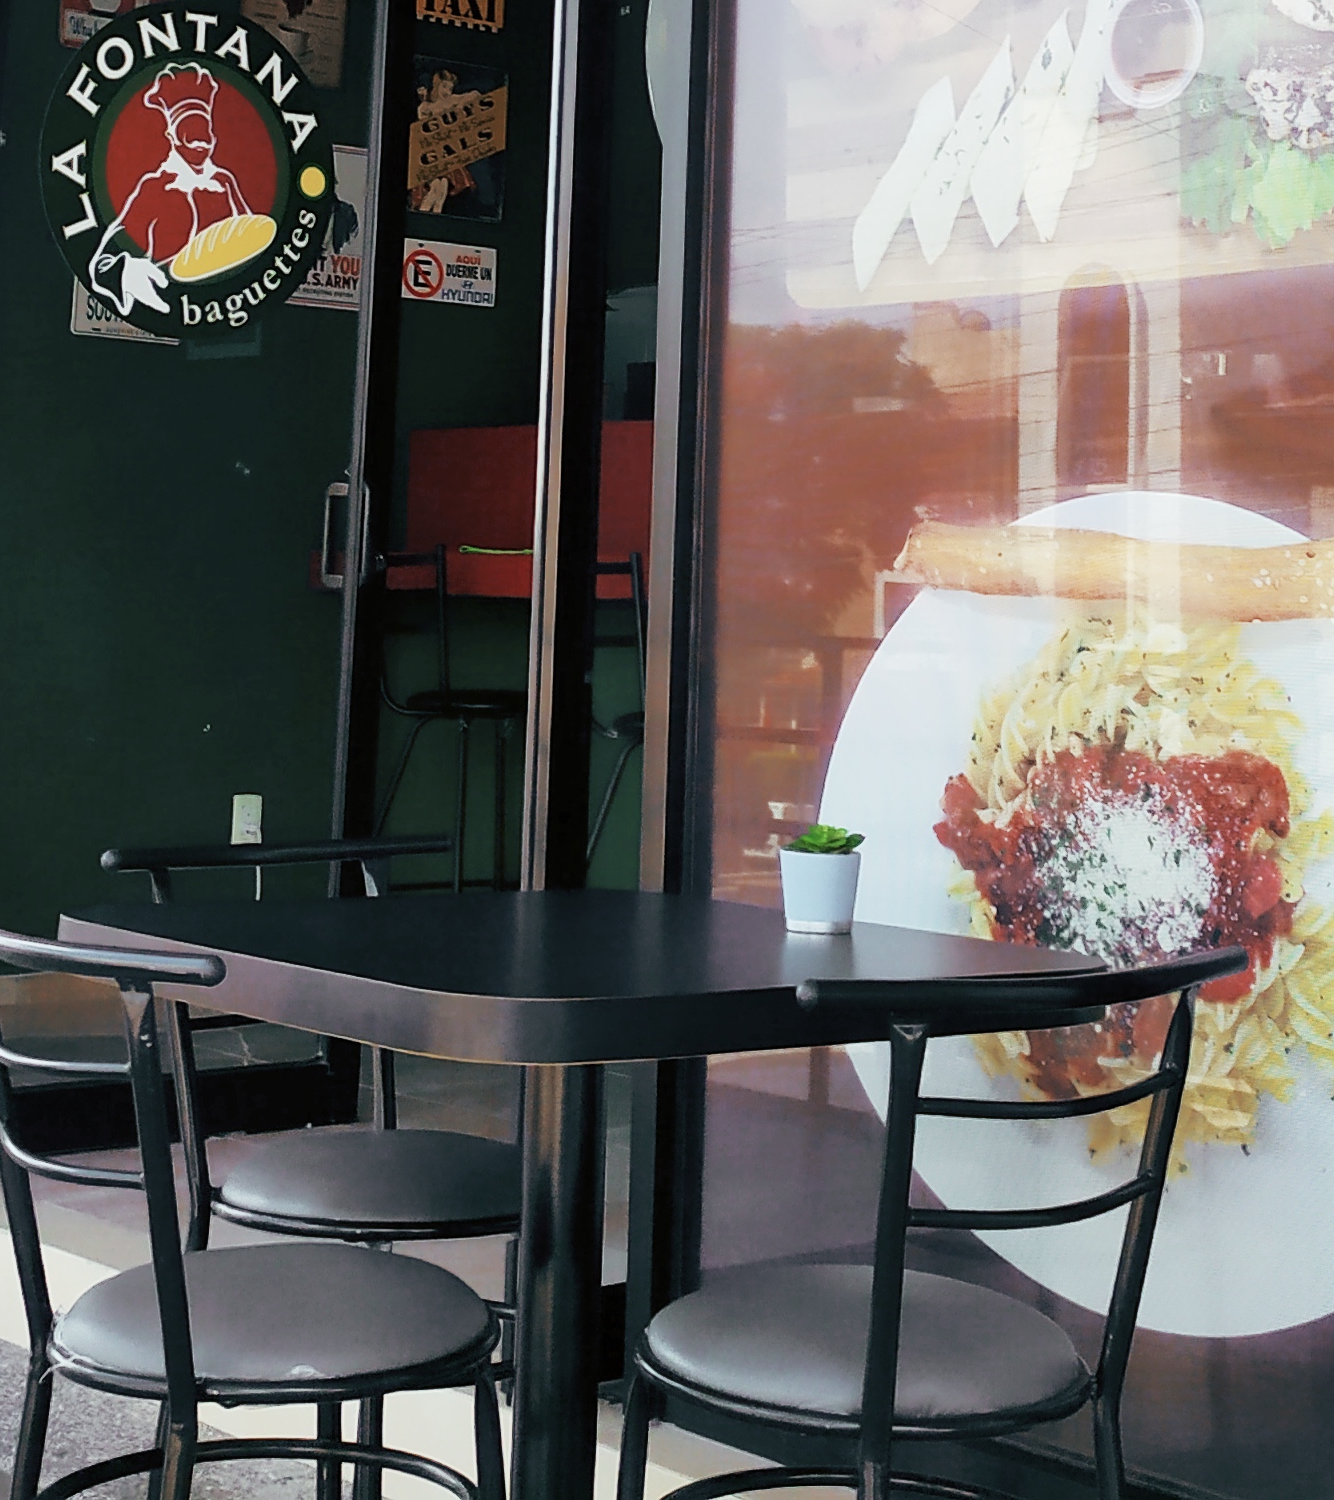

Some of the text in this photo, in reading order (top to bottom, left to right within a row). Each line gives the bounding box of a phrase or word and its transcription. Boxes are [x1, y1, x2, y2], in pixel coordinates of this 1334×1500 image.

[51, 10, 320, 240] LA FONTANA
[421, 94, 495, 134] GUYS
[420, 127, 493, 166] GALS
[180, 206, 318, 329] baguettes
[330, 254, 362, 277] YOU
[445, 263, 493, 281] DUERME UN
[325, 273, 359, 291] ARMY
[441, 288, 494, 306] HYUNDAI
